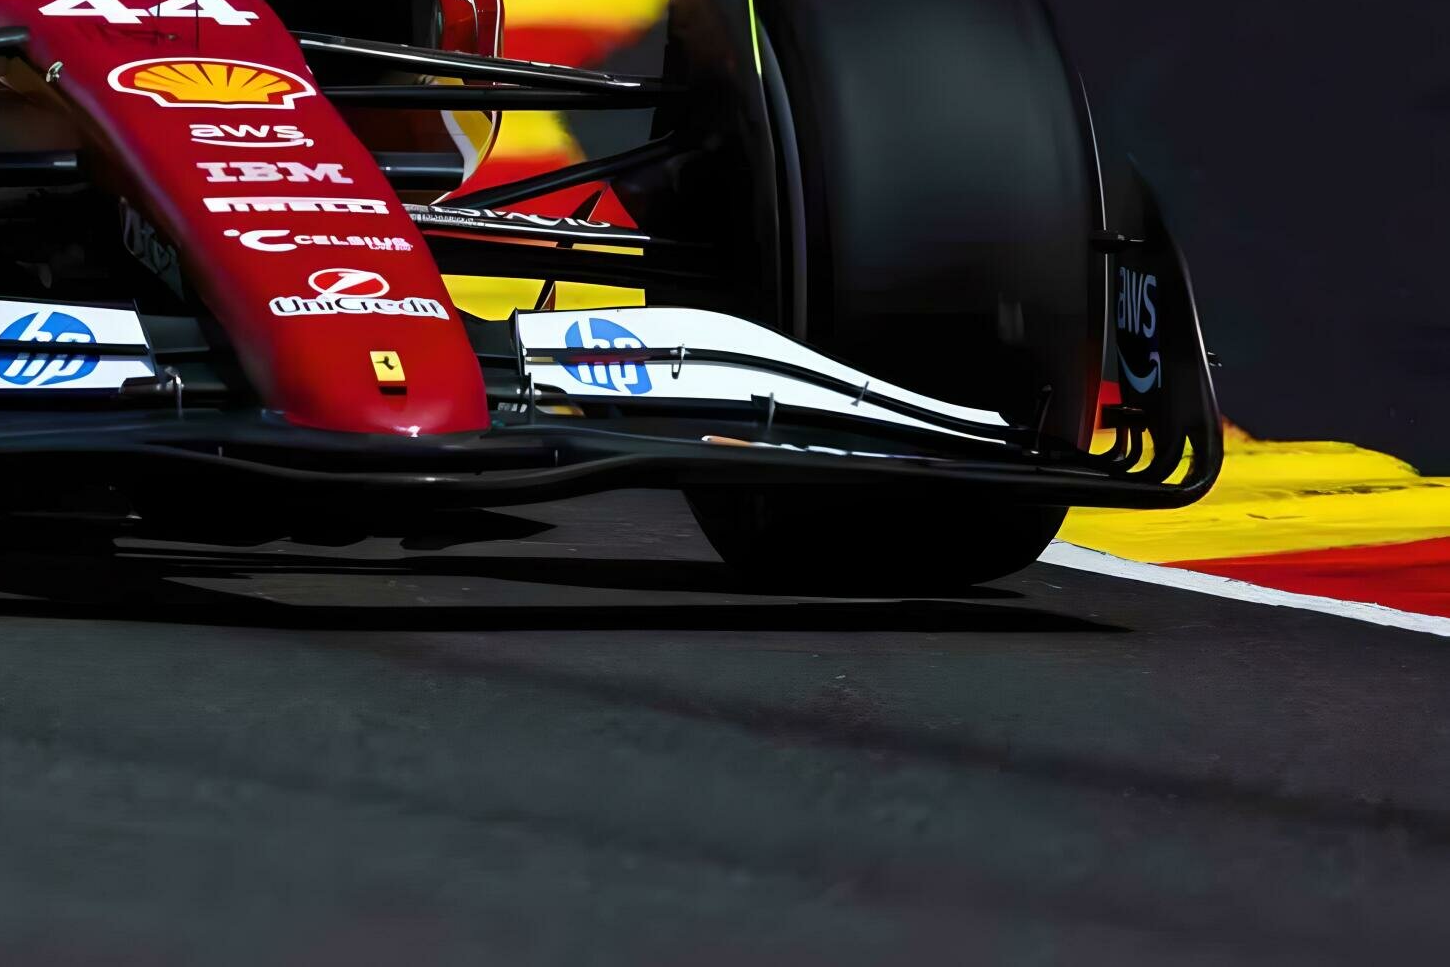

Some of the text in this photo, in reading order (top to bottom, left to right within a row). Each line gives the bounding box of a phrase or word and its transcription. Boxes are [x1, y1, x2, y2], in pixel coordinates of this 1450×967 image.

[188, 124, 306, 141] aws
[196, 161, 354, 184] IBM
[202, 196, 390, 215] PIRELLI
[270, 294, 449, 320] UniCredit
[1117, 266, 1158, 346] aws
[3, 311, 92, 386] hp
[576, 316, 644, 395] hp
